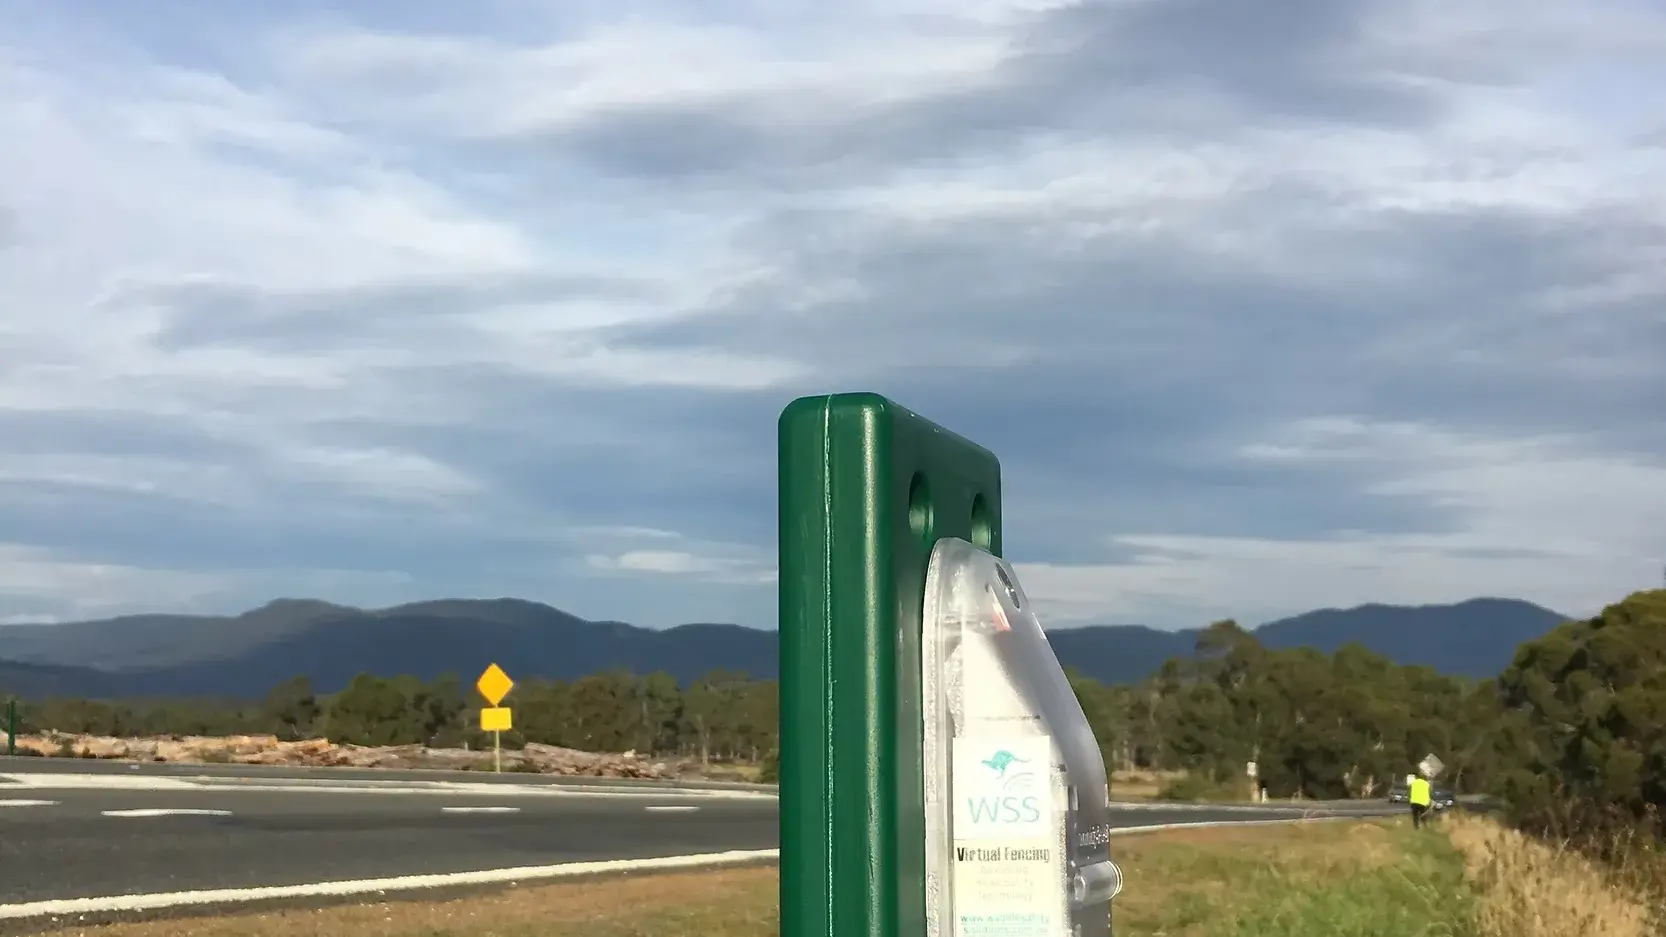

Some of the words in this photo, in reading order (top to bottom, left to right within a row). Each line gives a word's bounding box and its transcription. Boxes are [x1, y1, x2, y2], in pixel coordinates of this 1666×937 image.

[967, 796, 1040, 824] WSS
[957, 847, 1001, 862] Virtual
[1004, 847, 1050, 863] Fencing
